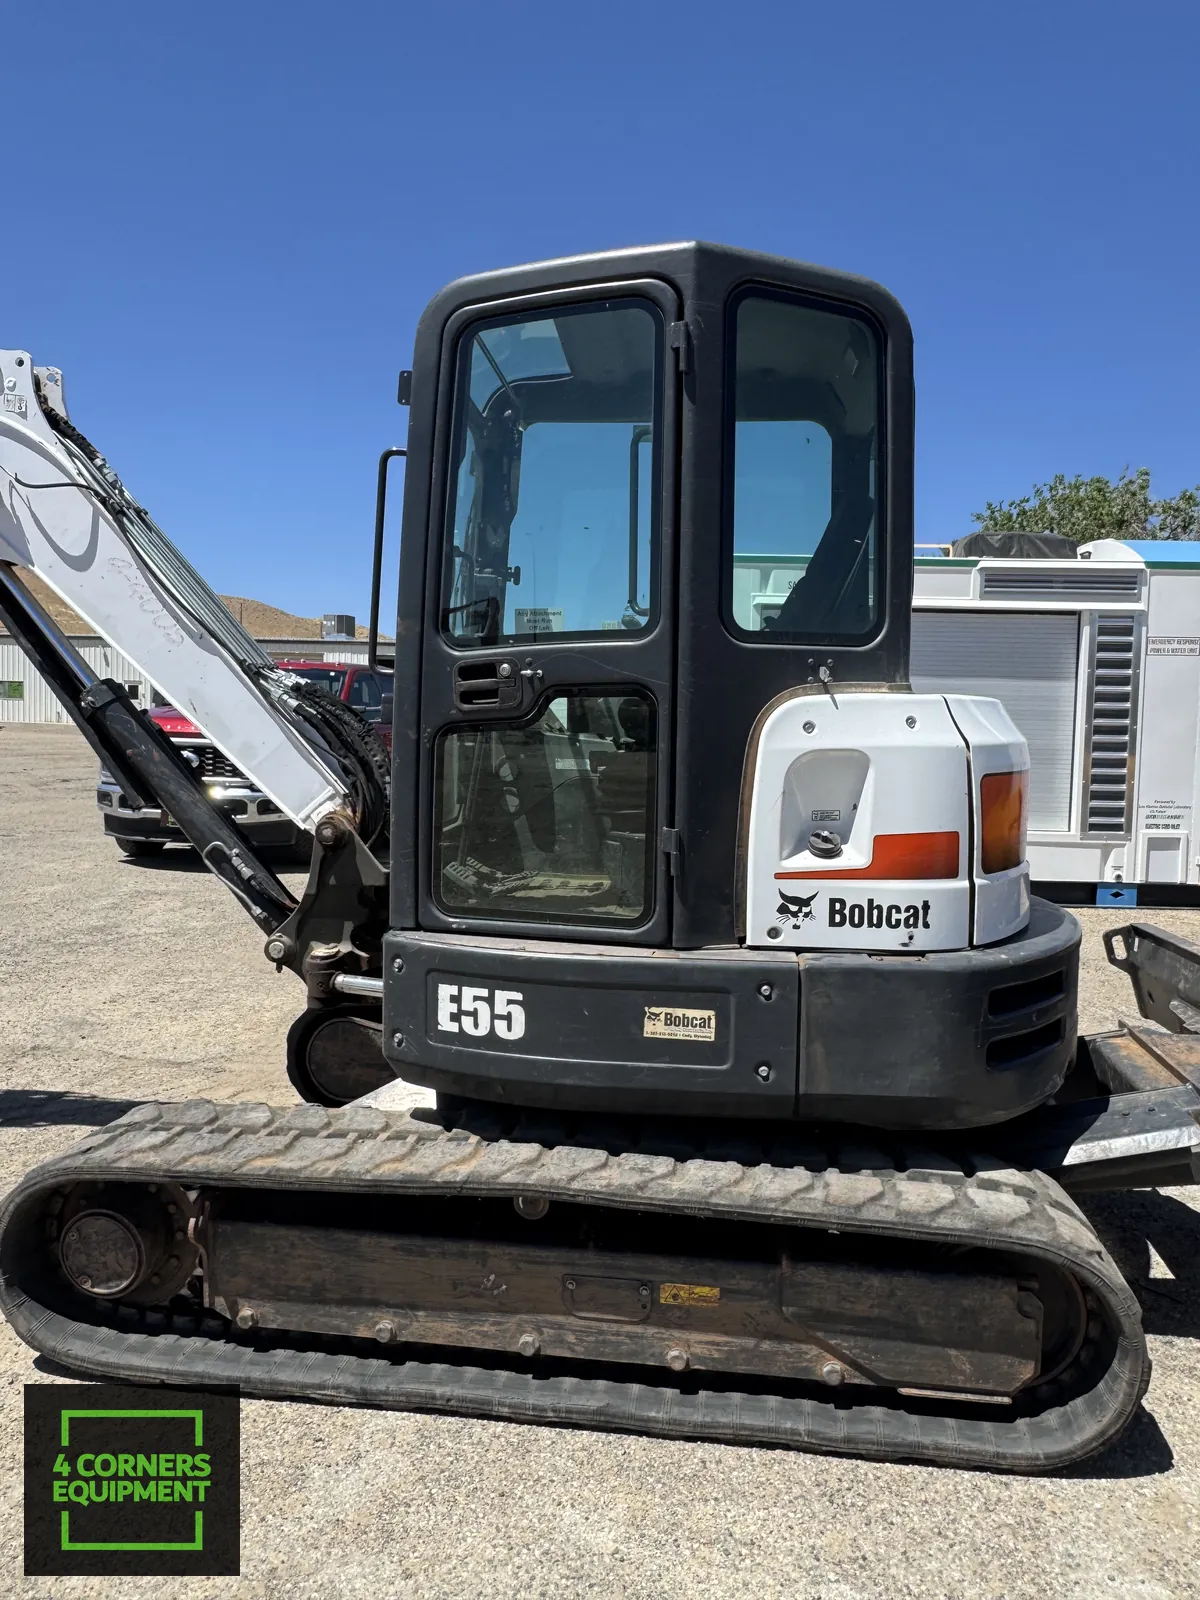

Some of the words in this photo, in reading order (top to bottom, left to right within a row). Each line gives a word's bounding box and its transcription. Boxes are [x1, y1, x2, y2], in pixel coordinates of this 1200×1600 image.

[828, 897, 931, 929] Bobcat
[437, 983, 525, 1040] E55
[664, 1012, 712, 1029] Bobcat
